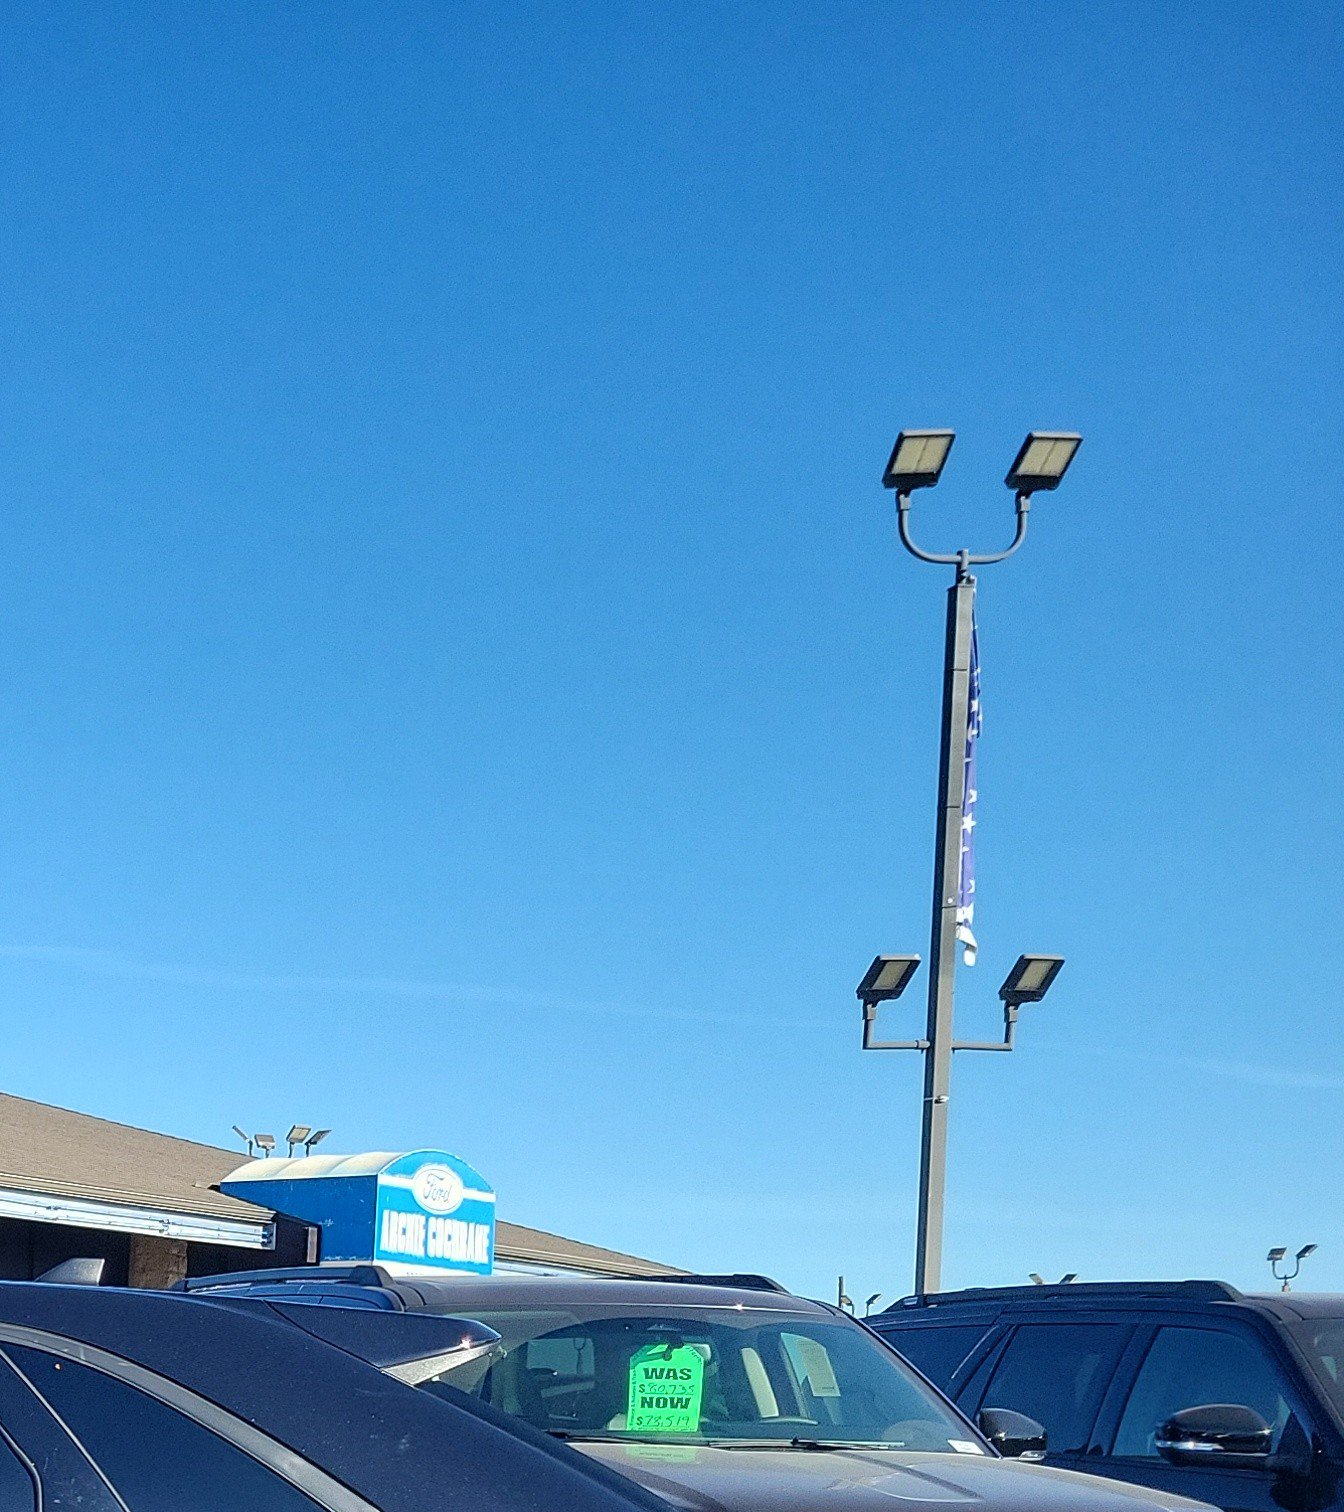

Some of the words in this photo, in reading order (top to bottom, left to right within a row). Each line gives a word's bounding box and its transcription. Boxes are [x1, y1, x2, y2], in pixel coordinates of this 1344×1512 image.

[423, 1173, 453, 1203] Ford
[379, 1209, 427, 1258] ARCHIE
[427, 1216, 490, 1264] COCHRANE
[643, 1367, 692, 1381] WAS
[640, 1396, 691, 1409] NOW
